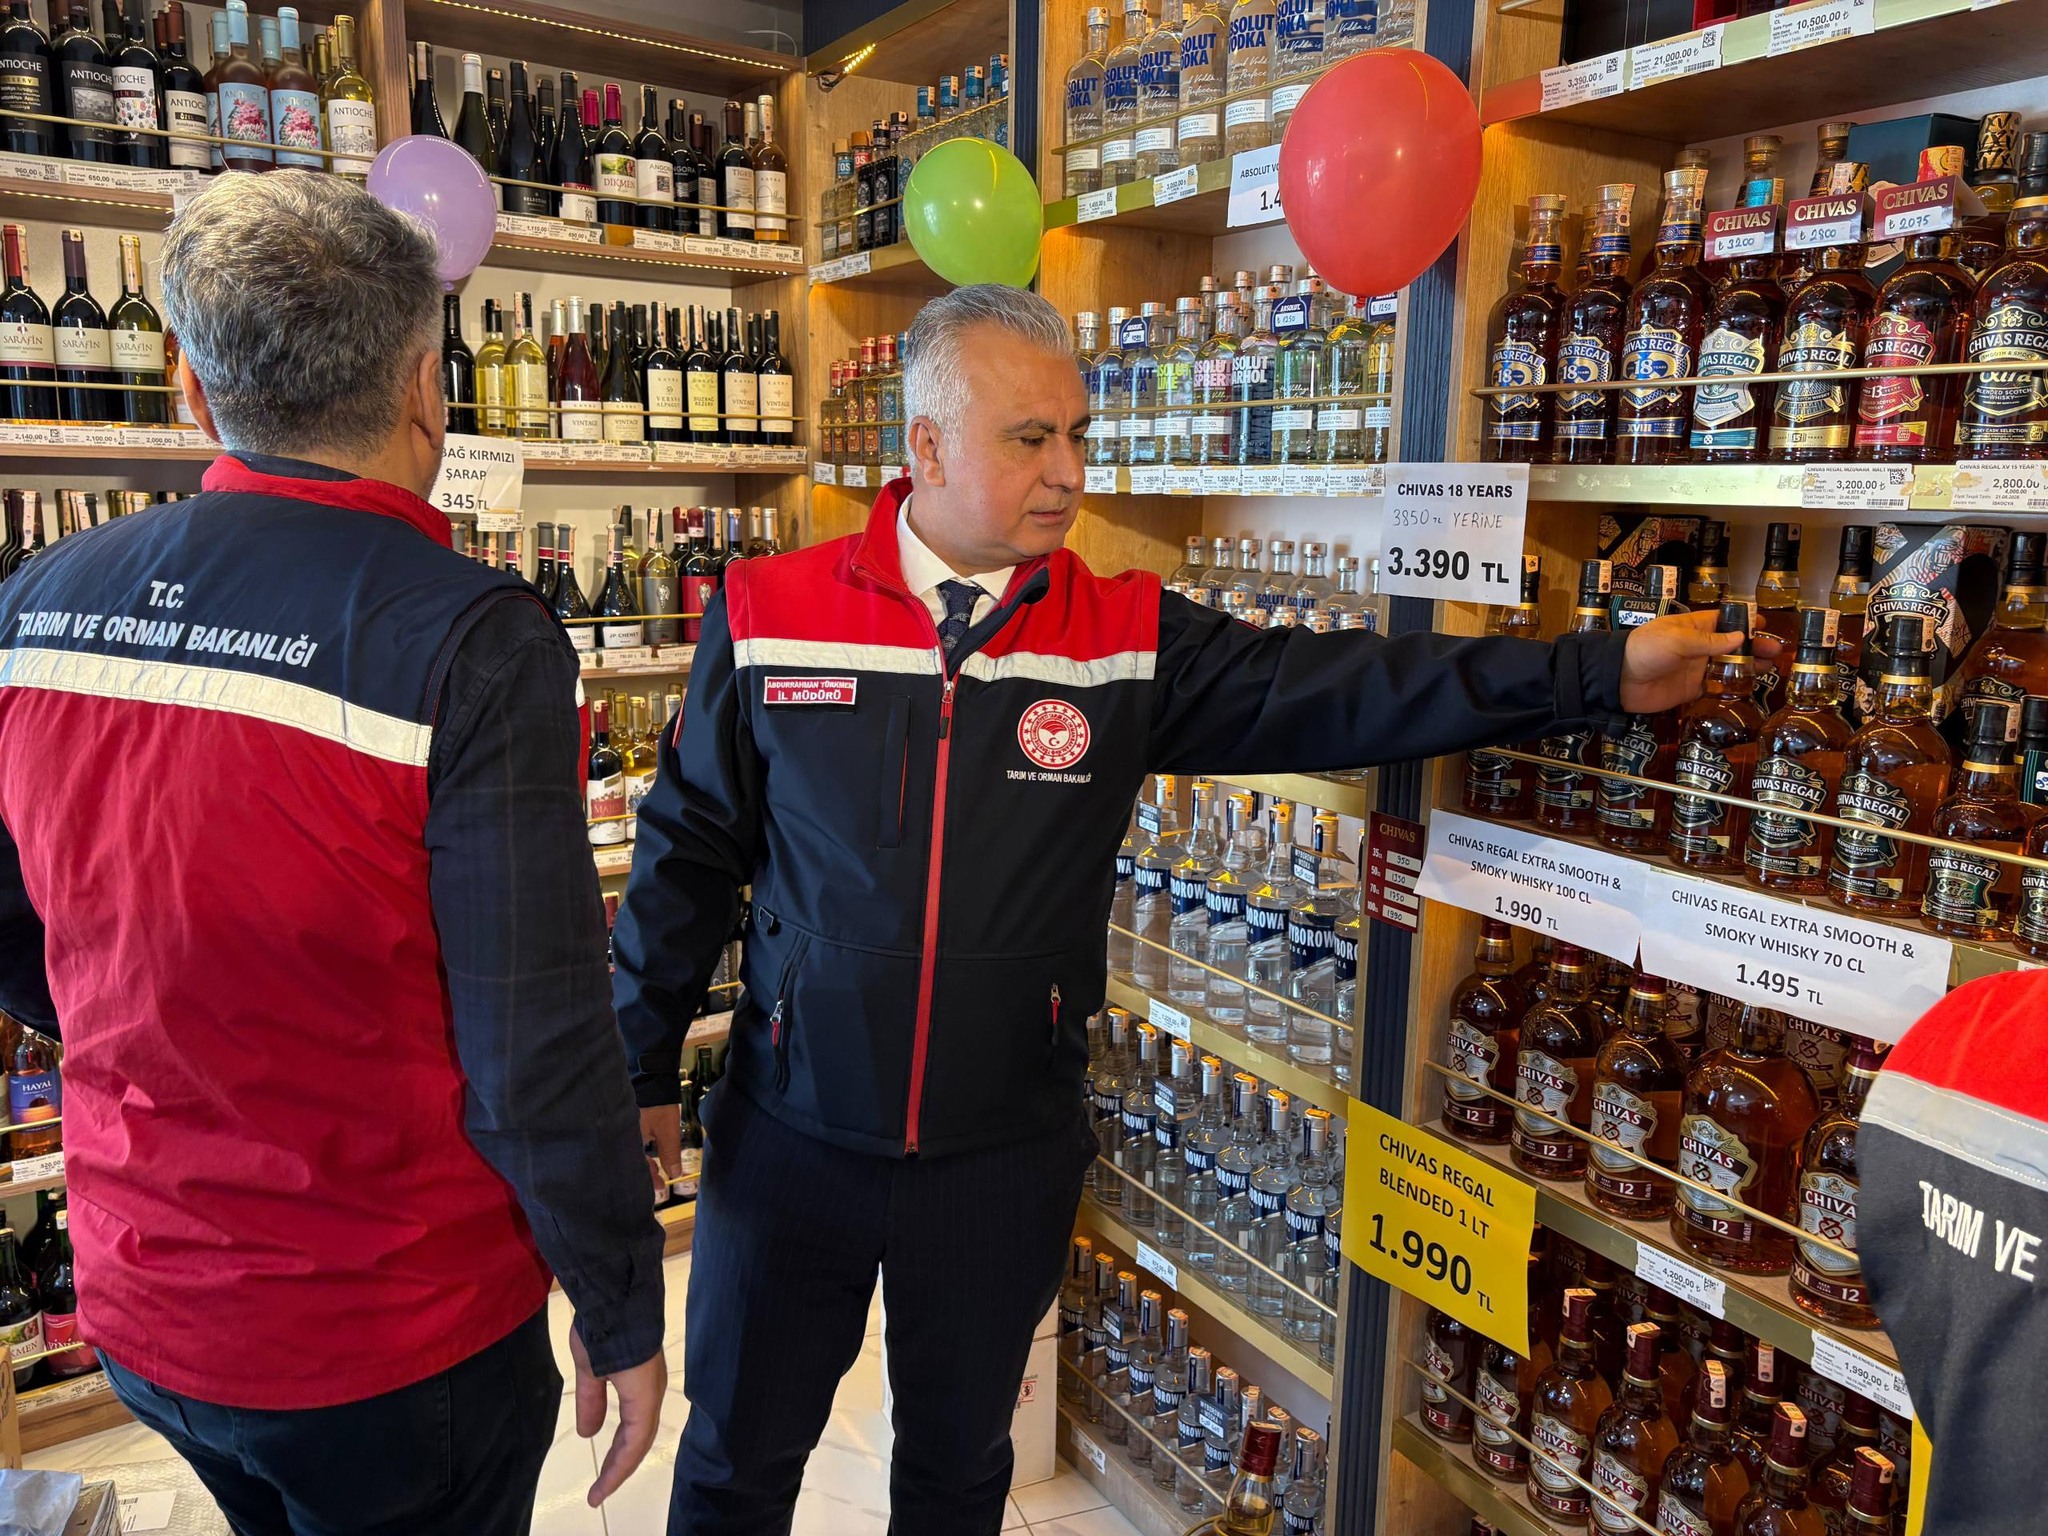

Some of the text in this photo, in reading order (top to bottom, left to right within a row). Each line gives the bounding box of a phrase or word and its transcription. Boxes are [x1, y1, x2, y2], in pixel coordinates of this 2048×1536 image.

[1796, 11, 1841, 30] 10,500.00
[1180, 33, 1217, 53] SOLUT
[1180, 51, 1209, 71] ODKA
[1654, 47, 1693, 66] 21,000.00
[1068, 77, 1099, 93] SOLUT
[1068, 92, 1092, 110] ODKA
[333, 106, 373, 118] ANTIOCHE
[1240, 164, 1271, 179] ABSOLUT
[603, 177, 636, 189] DİKMEN
[1882, 183, 1949, 210] CHIVAS
[1794, 199, 1857, 221] CHIVAS
[1713, 211, 1772, 233] CHIVAS
[1900, 214, 1931, 230] 2075
[1727, 238, 1755, 249] 3200
[1811, 229, 1837, 241] 2800
[1649, 338, 1687, 357] REGAL
[1884, 341, 1926, 358] REGAL
[1969, 333, 2012, 353] CHIVAS
[1509, 351, 1541, 368] REGAL
[1573, 346, 1608, 364] REGAL
[1720, 354, 1756, 371] REGAL
[1810, 349, 1850, 366] REGAL
[1497, 368, 1512, 382] 18
[1562, 364, 1577, 379] 18
[1634, 359, 1653, 374] 18
[1492, 424, 1511, 436] XVIII
[1557, 423, 1576, 434] XVIII
[1626, 423, 1652, 433] XVIII
[469, 449, 516, 463] KIRMIZI
[446, 467, 487, 481] ŞARAP
[1993, 478, 2040, 489] 2,800.00
[1397, 483, 1513, 498] CHIVAS 18 YEARS
[1836, 480, 1877, 490] 3,200.00
[442, 492, 490, 511] 345 TL
[1393, 508, 1429, 527] 3850
[1388, 547, 1510, 583] 3.390 TL
[148, 580, 184, 608] T.C.
[1624, 600, 1656, 611] CHIVAS
[1873, 601, 1942, 619] CHIVAS REGAL
[16, 611, 319, 668] TARIM VE ORMAN BAKANLIĞI
[777, 689, 842, 701] İL MÜDÜRÜ
[1006, 770, 1027, 781] TARIM
[1027, 771, 1037, 781] VE
[1037, 771, 1062, 783] ORMAN
[1693, 764, 1728, 783] REGAL
[1752, 779, 1821, 802] CHIVAS REGAL
[1865, 799, 1904, 820] REGAL
[1379, 823, 1416, 843] CHIVAS
[1448, 832, 1621, 890] CHIVAS REGAL EXTRA SMOOTH &
[1929, 858, 2000, 880] CHIVAS REGAL
[1471, 860, 1592, 904] SMOKY WHISKY 100 CL
[1495, 896, 1559, 931] 1.990 TL
[1671, 889, 1915, 959] CHIVAS REGAL EXTRA SMOOTH &
[1704, 923, 1866, 974] SMOKY WHISKY 70 CL
[1735, 963, 1824, 1006] 1.495 TL
[1788, 1018, 1842, 1042] CHIVAS
[1518, 1065, 1565, 1090] CHIVAS
[1465, 1109, 1479, 1121] 12
[1593, 1098, 1642, 1126] CHIVAS
[1543, 1144, 1558, 1156] 12
[1682, 1136, 1735, 1169] CHIVAS
[1380, 1133, 1495, 1207] CHIVAS REGAL
[1619, 1182, 1635, 1195] 12
[1380, 1167, 1490, 1239] BLENDED 1 LT
[1805, 1190, 1857, 1218] CHIVA
[1711, 1219, 1729, 1235] 12
[1919, 1180, 2042, 1283] TARIM VE
[1369, 1213, 1494, 1314] 1.990 TL
[1662, 1267, 1695, 1288] 4,200.00
[1841, 1288, 1860, 1302] 12
[1843, 1361, 1882, 1387] 1,990.00
[1799, 1385, 1845, 1415] CHIVAS
[1427, 1409, 1438, 1422] 12
[1533, 1426, 1578, 1455] CHIVAS
[1489, 1452, 1501, 1465] 12
[1592, 1460, 1635, 1496] CHIVAS
[1556, 1499, 1571, 1512] 12
